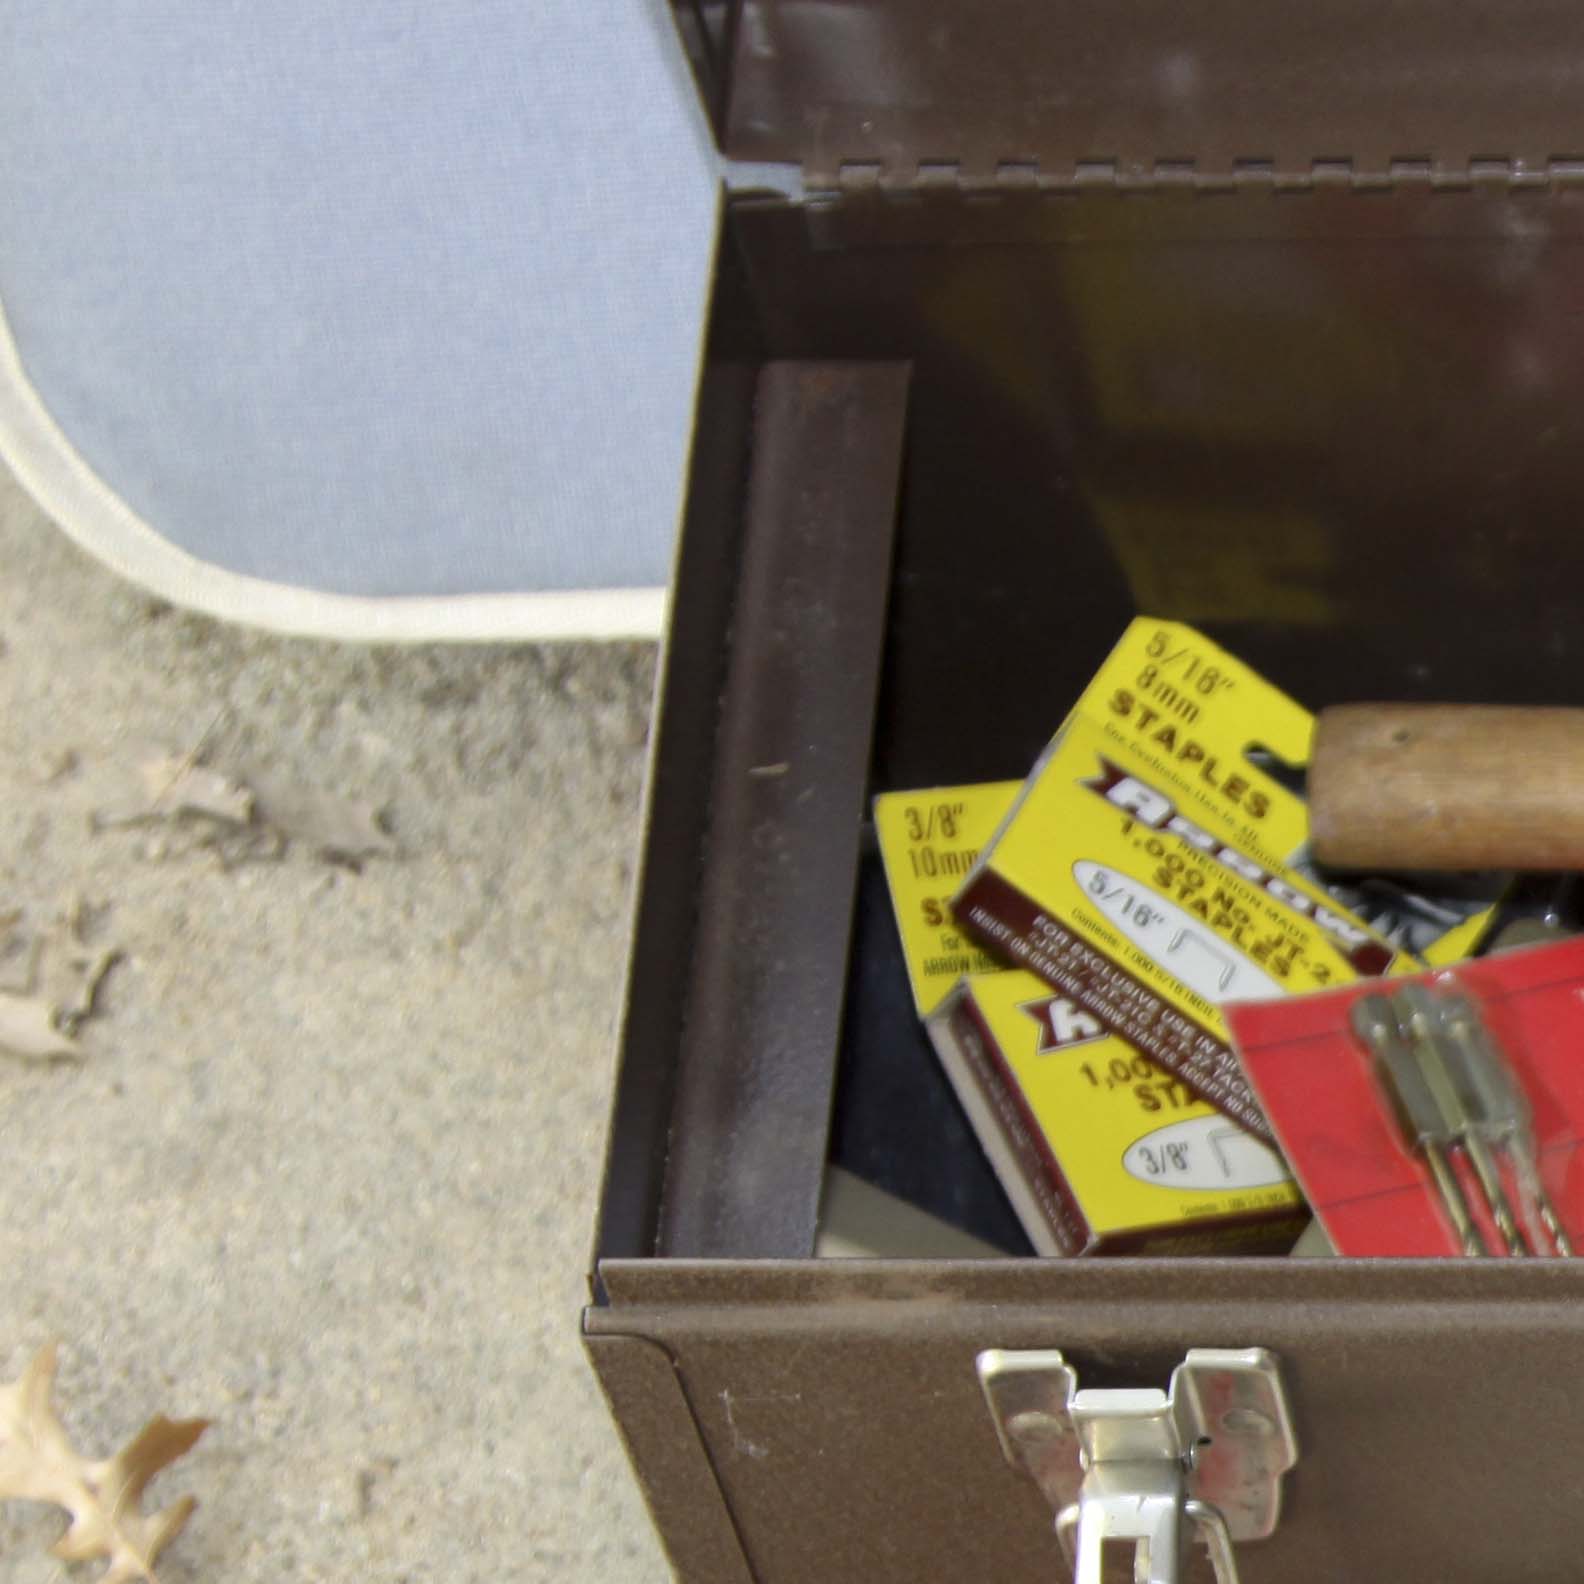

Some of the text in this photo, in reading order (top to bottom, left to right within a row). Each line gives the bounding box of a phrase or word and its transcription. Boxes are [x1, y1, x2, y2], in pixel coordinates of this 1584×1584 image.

[1135, 662, 1204, 725] 8mm
[1106, 687, 1274, 822] STAPLES
[902, 797, 969, 844] 3/8"
[1105, 777, 1373, 945] ARROW
[1150, 864, 1296, 980] STAPLES
[1266, 929, 1333, 984] JT-2
[1137, 1140, 1191, 1177] 3/8"
